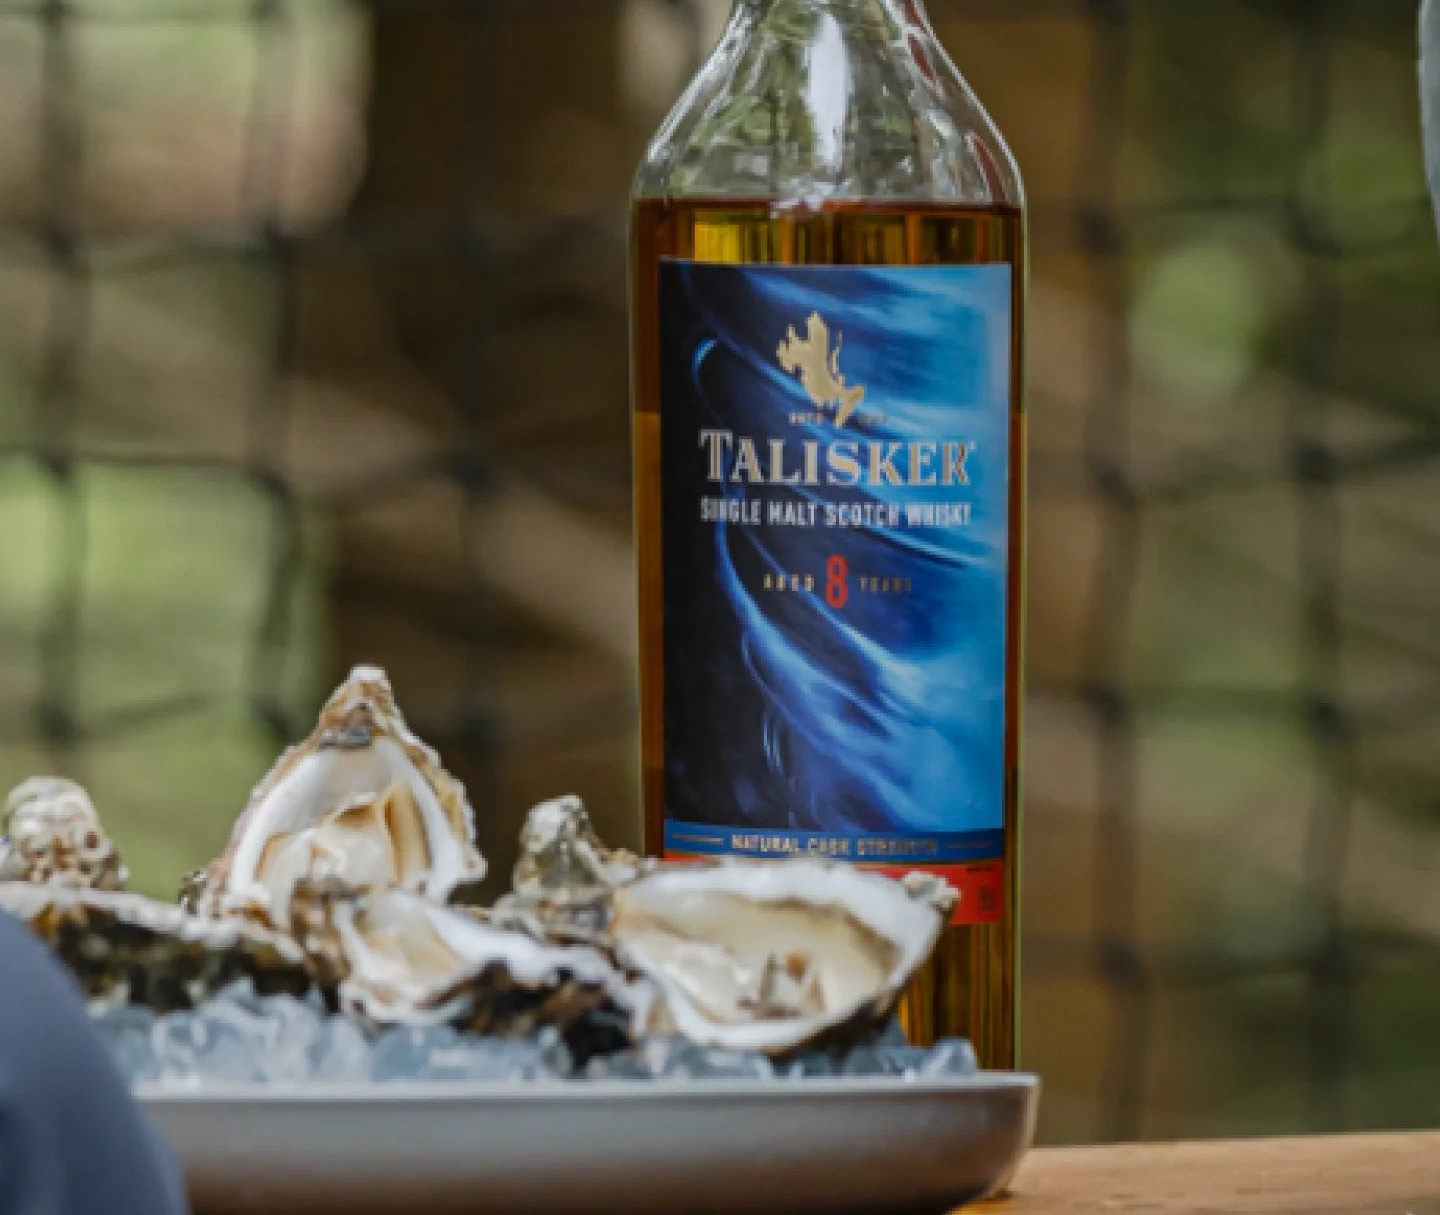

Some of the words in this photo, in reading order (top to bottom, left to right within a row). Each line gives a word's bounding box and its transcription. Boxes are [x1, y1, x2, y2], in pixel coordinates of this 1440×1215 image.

[698, 428, 973, 486] TALISKER
[700, 495, 762, 525] SINGLE
[767, 500, 816, 526] MALT
[825, 500, 900, 527] SCOTCH
[905, 501, 972, 527] WHISKY
[825, 553, 849, 608] 8
[731, 834, 799, 854] NATURAL
